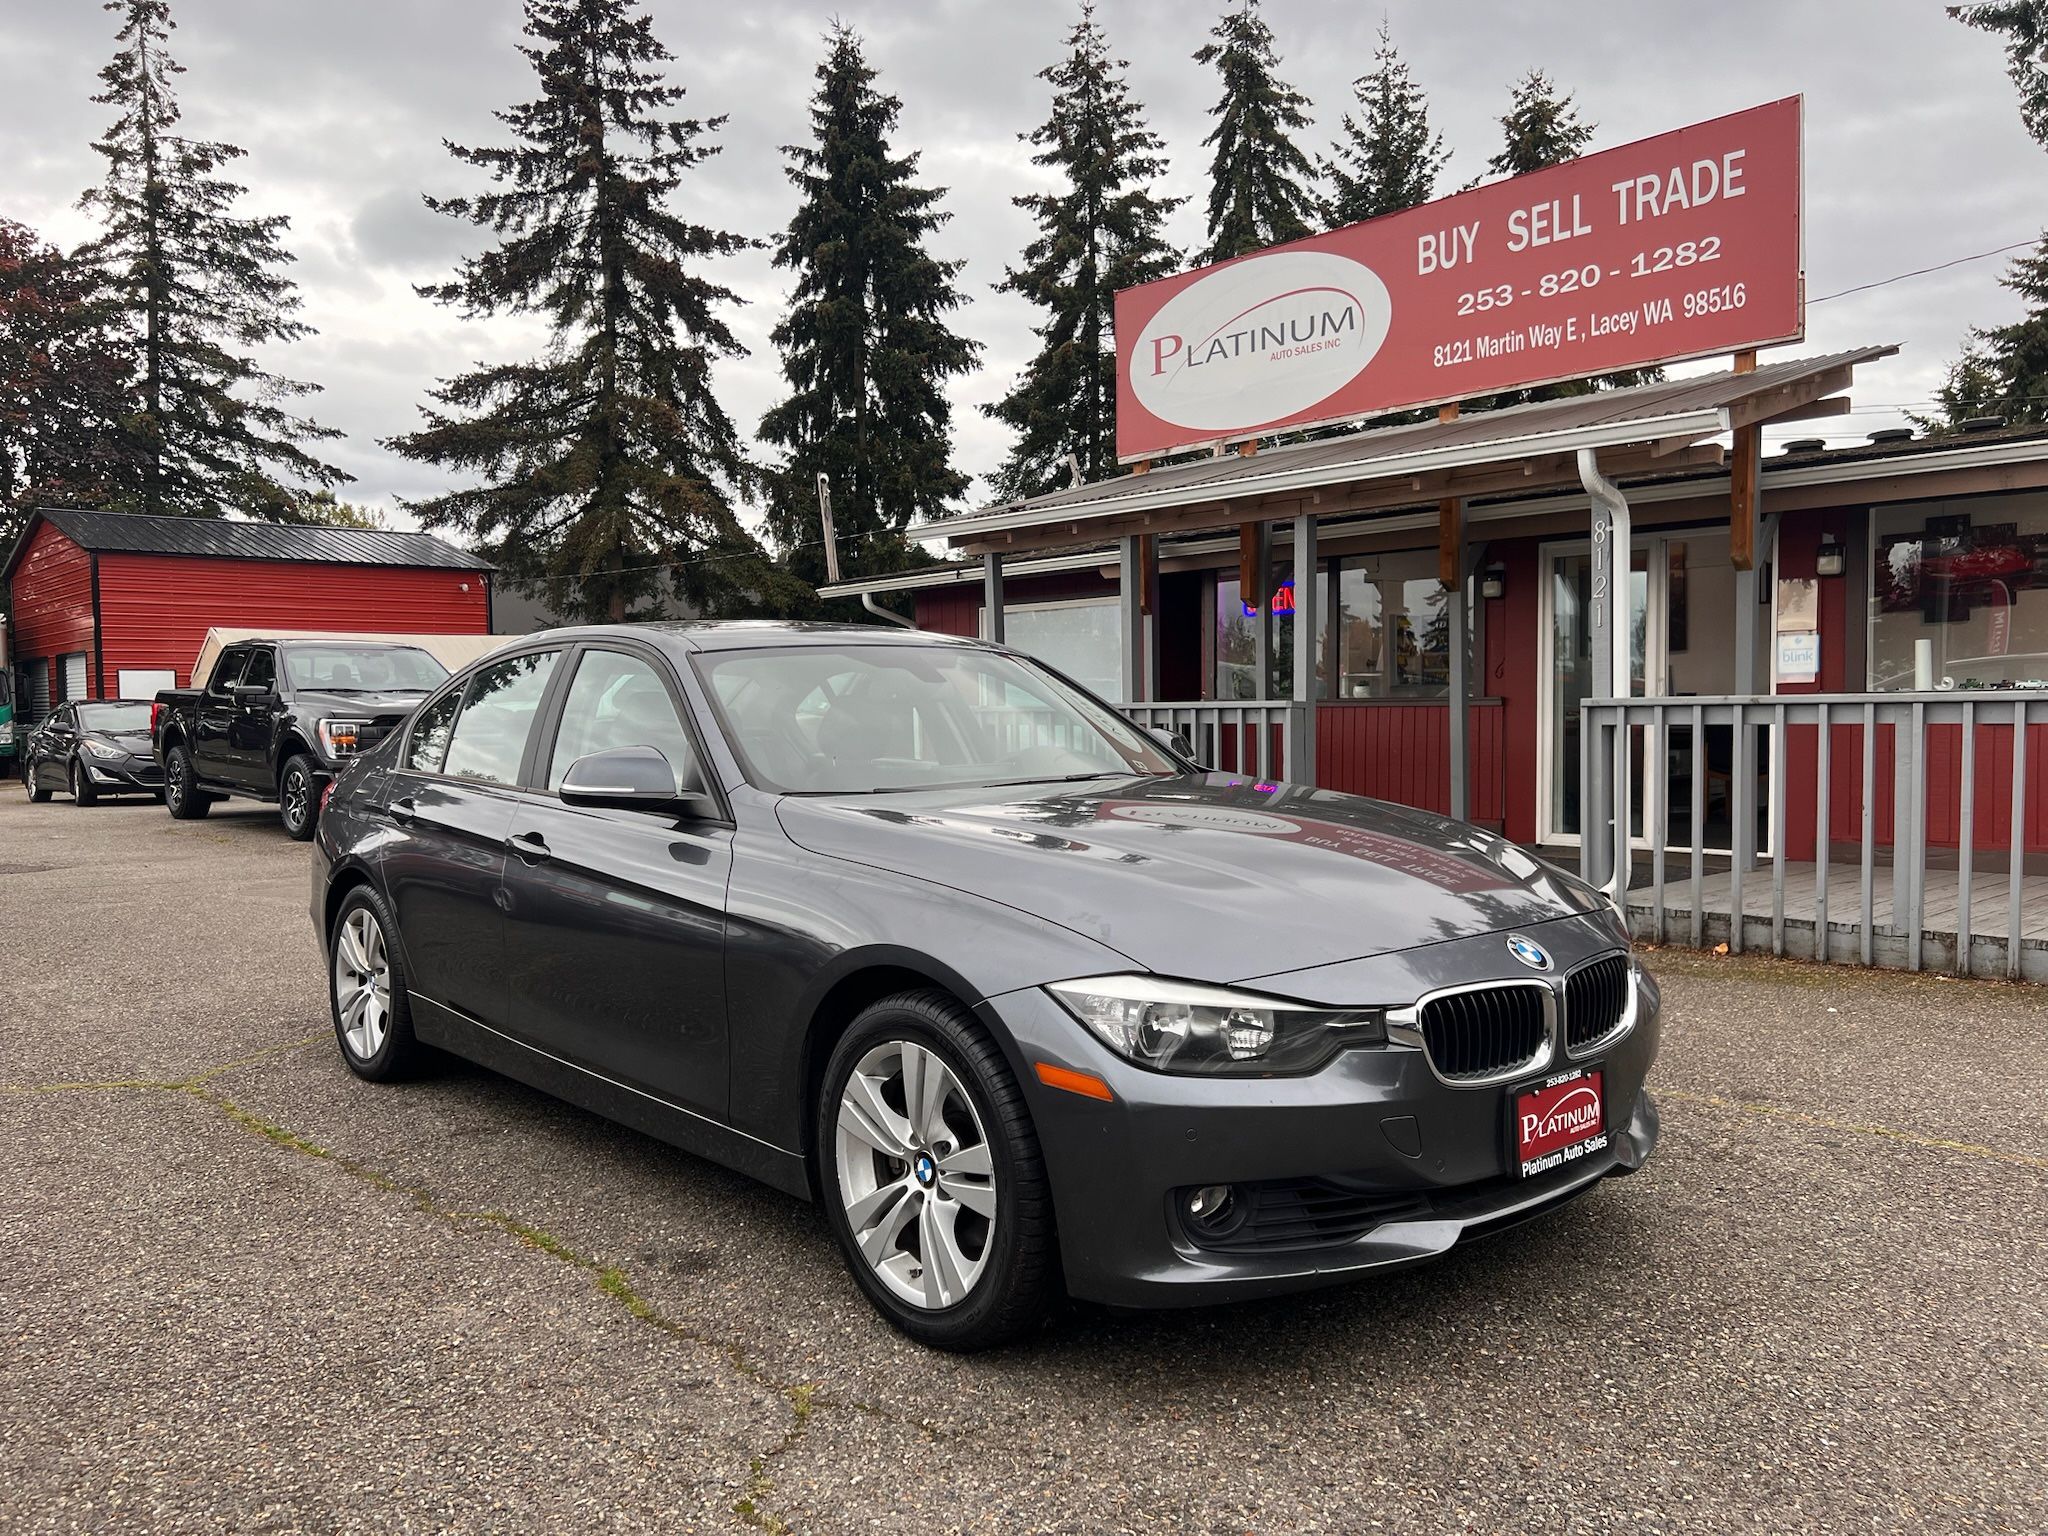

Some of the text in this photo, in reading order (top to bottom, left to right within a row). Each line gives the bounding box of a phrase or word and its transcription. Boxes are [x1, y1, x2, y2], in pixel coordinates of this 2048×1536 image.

[1417, 148, 1746, 276] BUY SELL TRADE
[1457, 283, 1514, 317] 253
[1539, 263, 1601, 298] 820
[1630, 235, 1722, 279] 1282
[1149, 305, 1356, 377] PLATINUM
[1269, 337, 1341, 362] AUTO SALES INC
[1433, 337, 1473, 368] 8121
[1476, 329, 1525, 360] Martin
[1529, 318, 1563, 350] Way
[1590, 309, 1639, 338] Lacey
[1643, 297, 1674, 326] WA
[1683, 281, 1747, 319] 98516
[1782, 649, 1814, 664] blink
[1521, 1101, 1600, 1144] PLATINUM
[1521, 1135, 1608, 1178] Platinum Auto Sales
